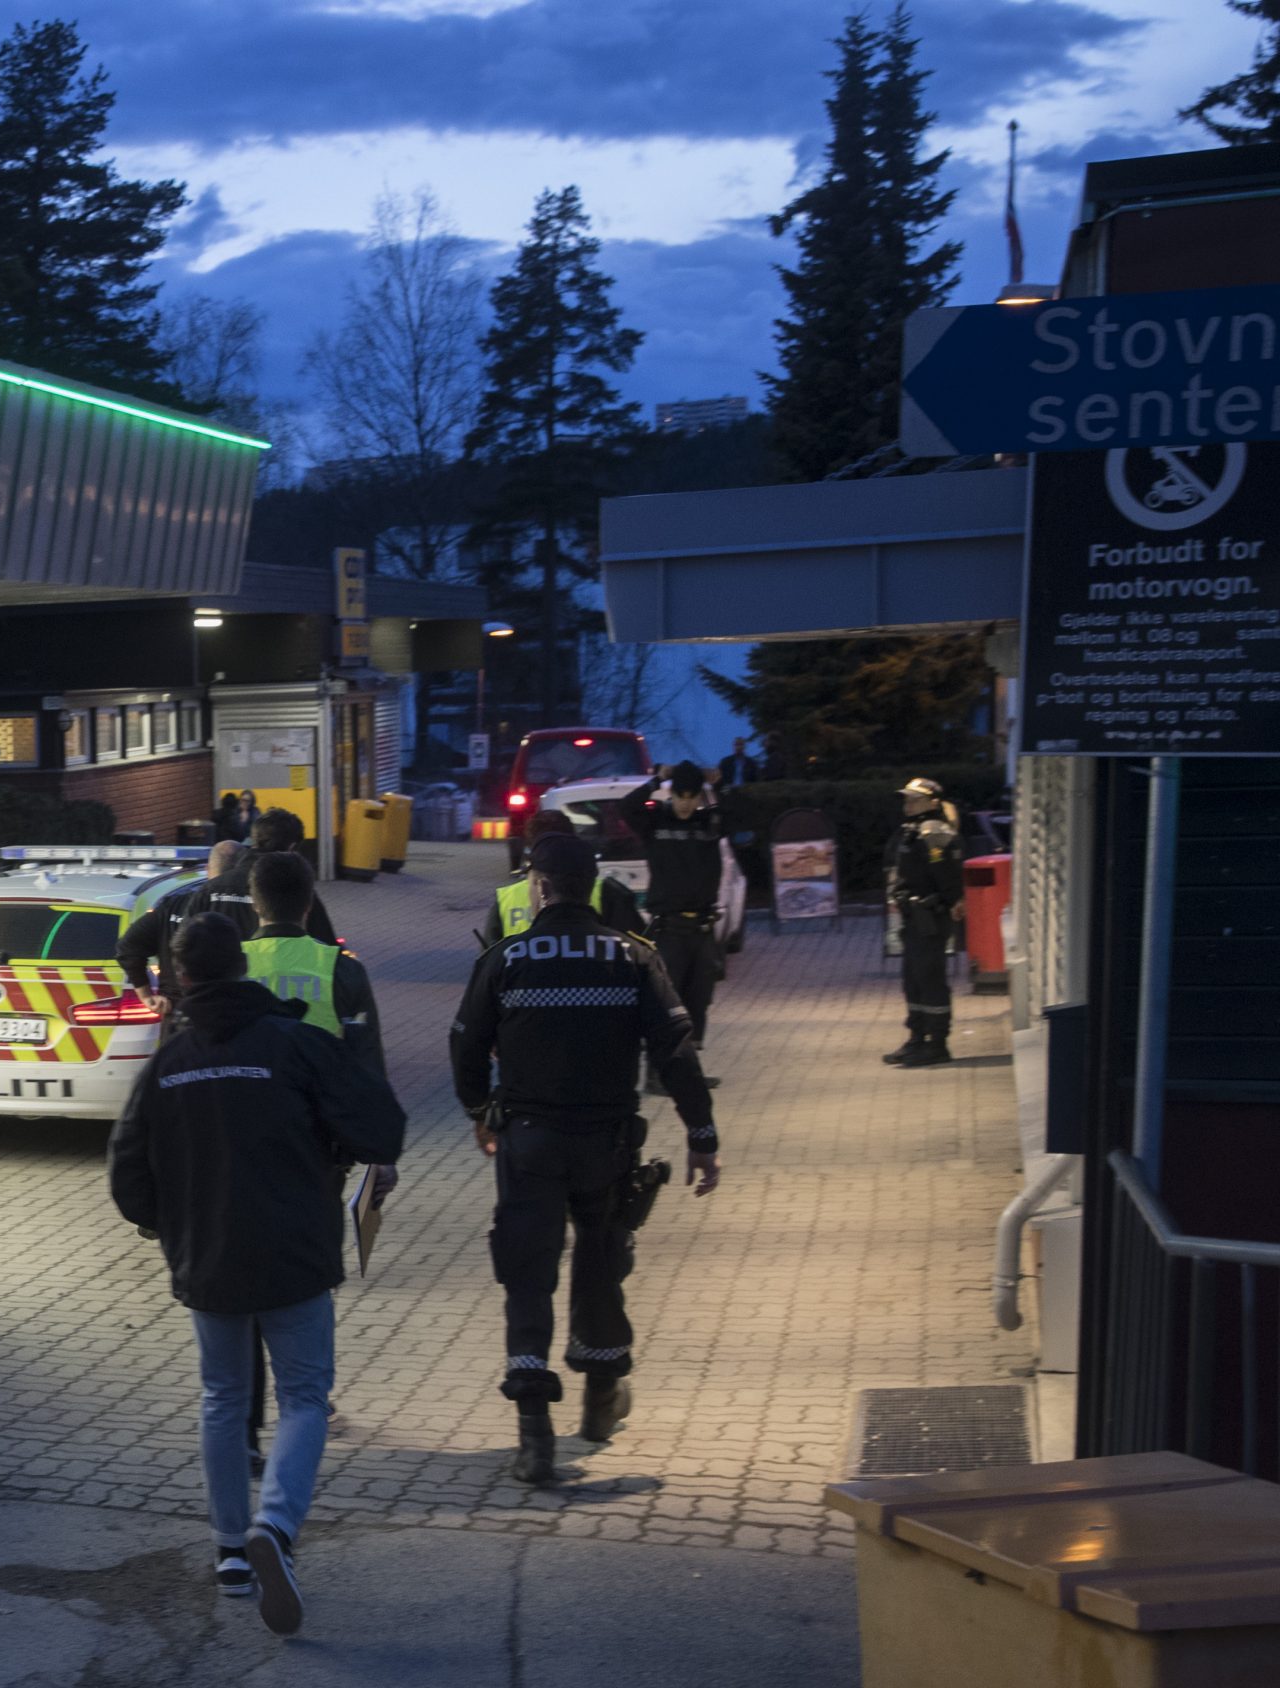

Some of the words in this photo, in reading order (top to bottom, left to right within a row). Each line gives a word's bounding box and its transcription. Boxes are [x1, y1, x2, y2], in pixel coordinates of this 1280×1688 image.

[1030, 306, 1276, 373] Stovn
[1026, 372, 1280, 444] sente
[1088, 539, 1205, 567] Forbudt
[1218, 537, 1265, 560] for
[1088, 576, 1260, 600] motorvogn.
[1059, 613, 1121, 629] Gjelder
[1126, 610, 1164, 625] ikke
[1170, 606, 1280, 624] varelevering
[1054, 630, 1116, 645] mellom
[1174, 630, 1200, 645] og
[1049, 671, 1161, 686] Overtredelse
[1164, 670, 1200, 685] kan
[1089, 691, 1114, 706] og
[1215, 688, 1243, 702] for
[1084, 708, 1151, 724] regning
[1154, 709, 1179, 724] og
